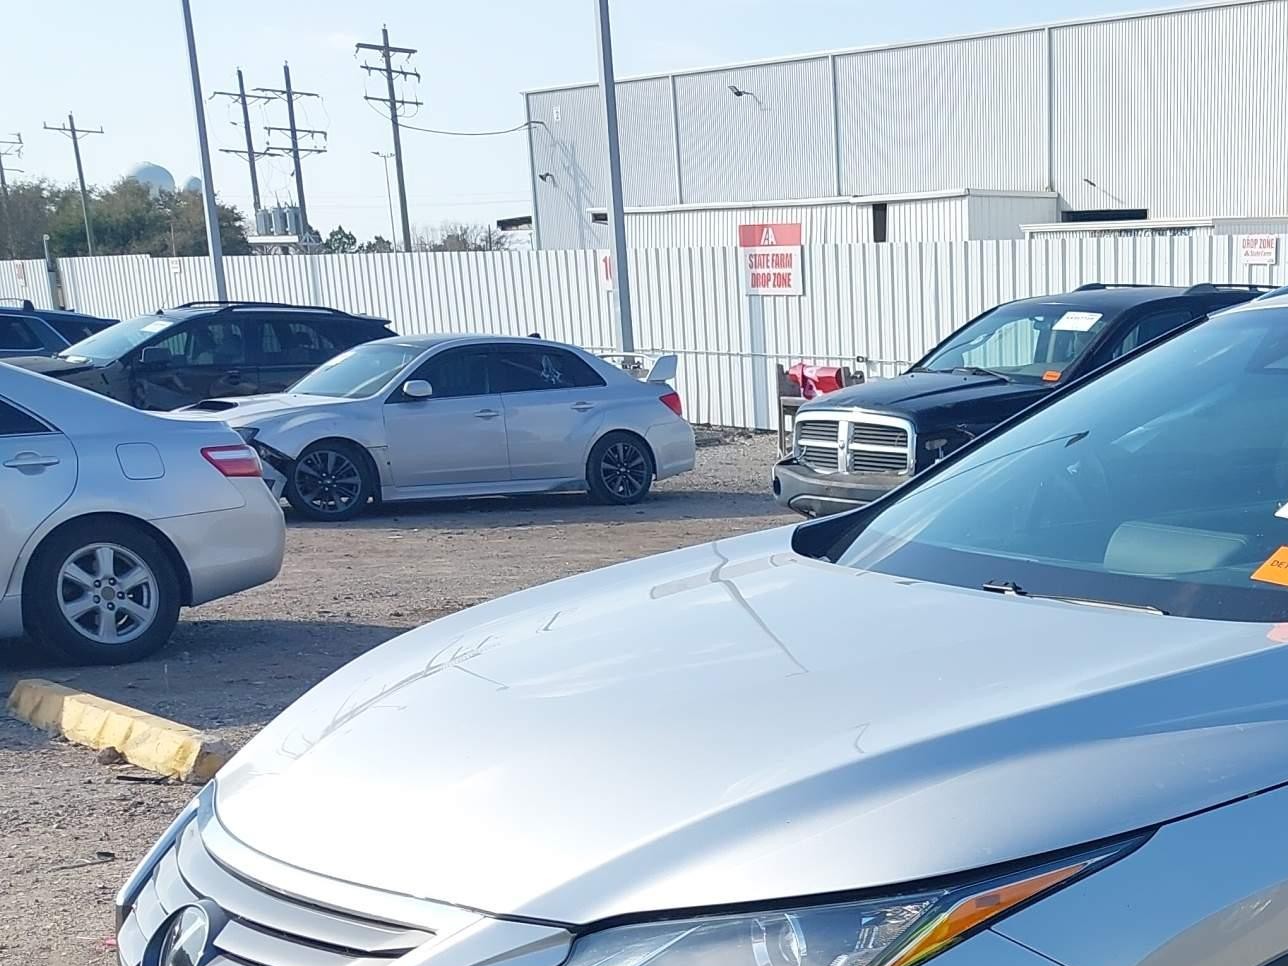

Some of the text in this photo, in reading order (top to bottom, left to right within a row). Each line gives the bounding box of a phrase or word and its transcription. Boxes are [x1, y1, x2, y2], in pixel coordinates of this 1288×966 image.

[748, 253, 793, 270] STATE FARM
[751, 272, 792, 289] DROP ZONE
